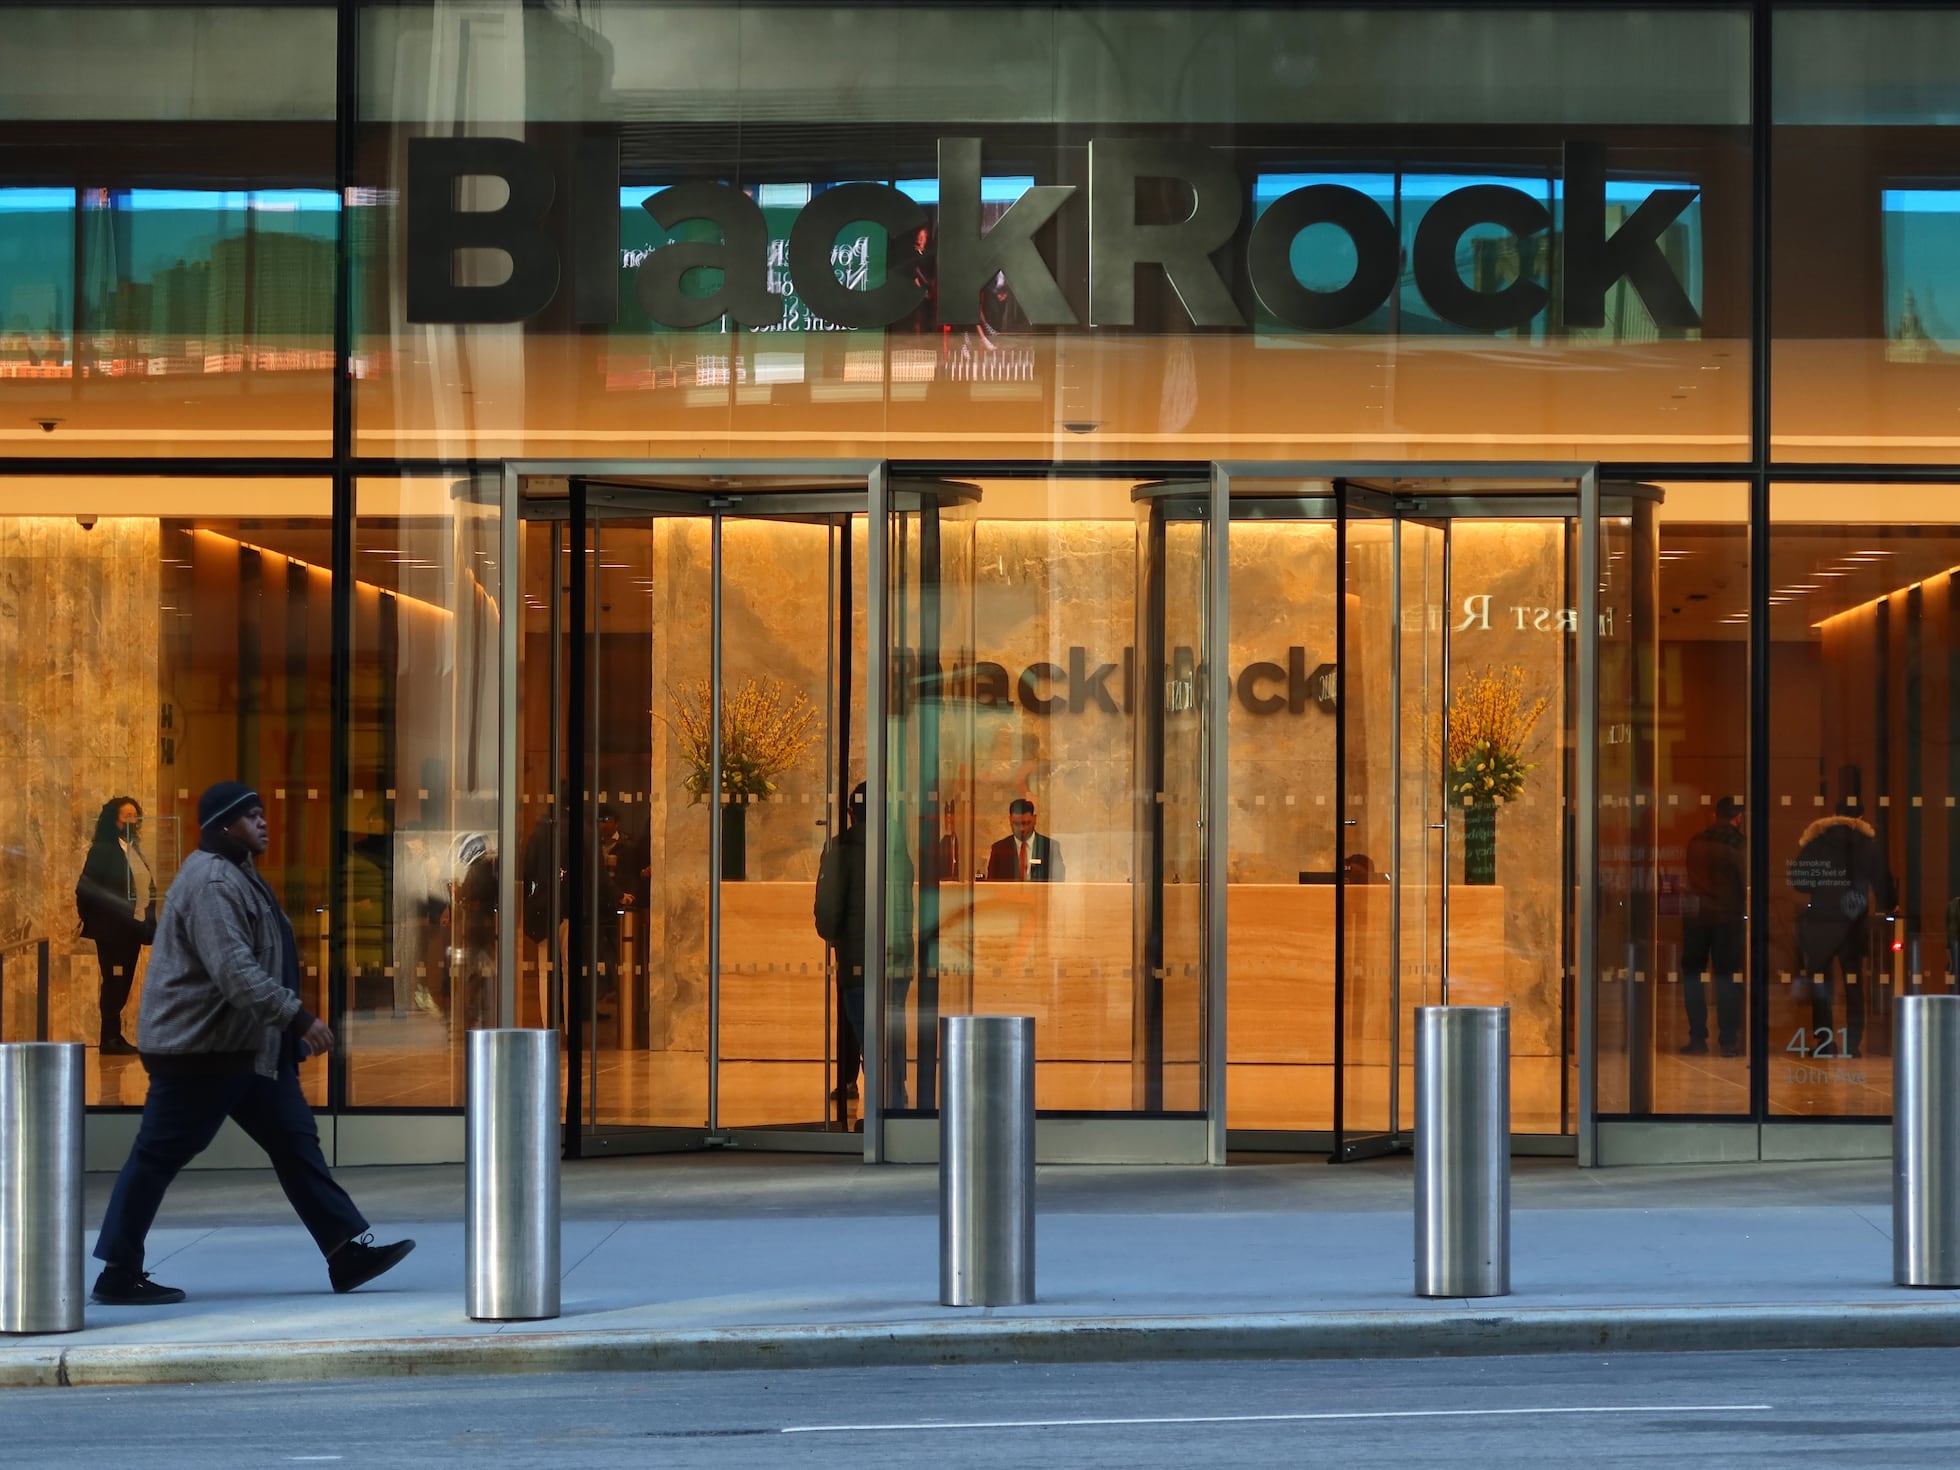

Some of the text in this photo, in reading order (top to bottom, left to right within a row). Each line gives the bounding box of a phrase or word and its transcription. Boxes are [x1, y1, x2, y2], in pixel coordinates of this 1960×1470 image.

[407, 136, 1702, 331] BlackRock
[1799, 859, 1831, 869] smoking
[1786, 869, 1847, 877] within 25 feet of
[1786, 879, 1851, 888] building entrance
[1786, 1026, 1853, 1059] 421
[1785, 1065, 1867, 1085] 10th Ave
